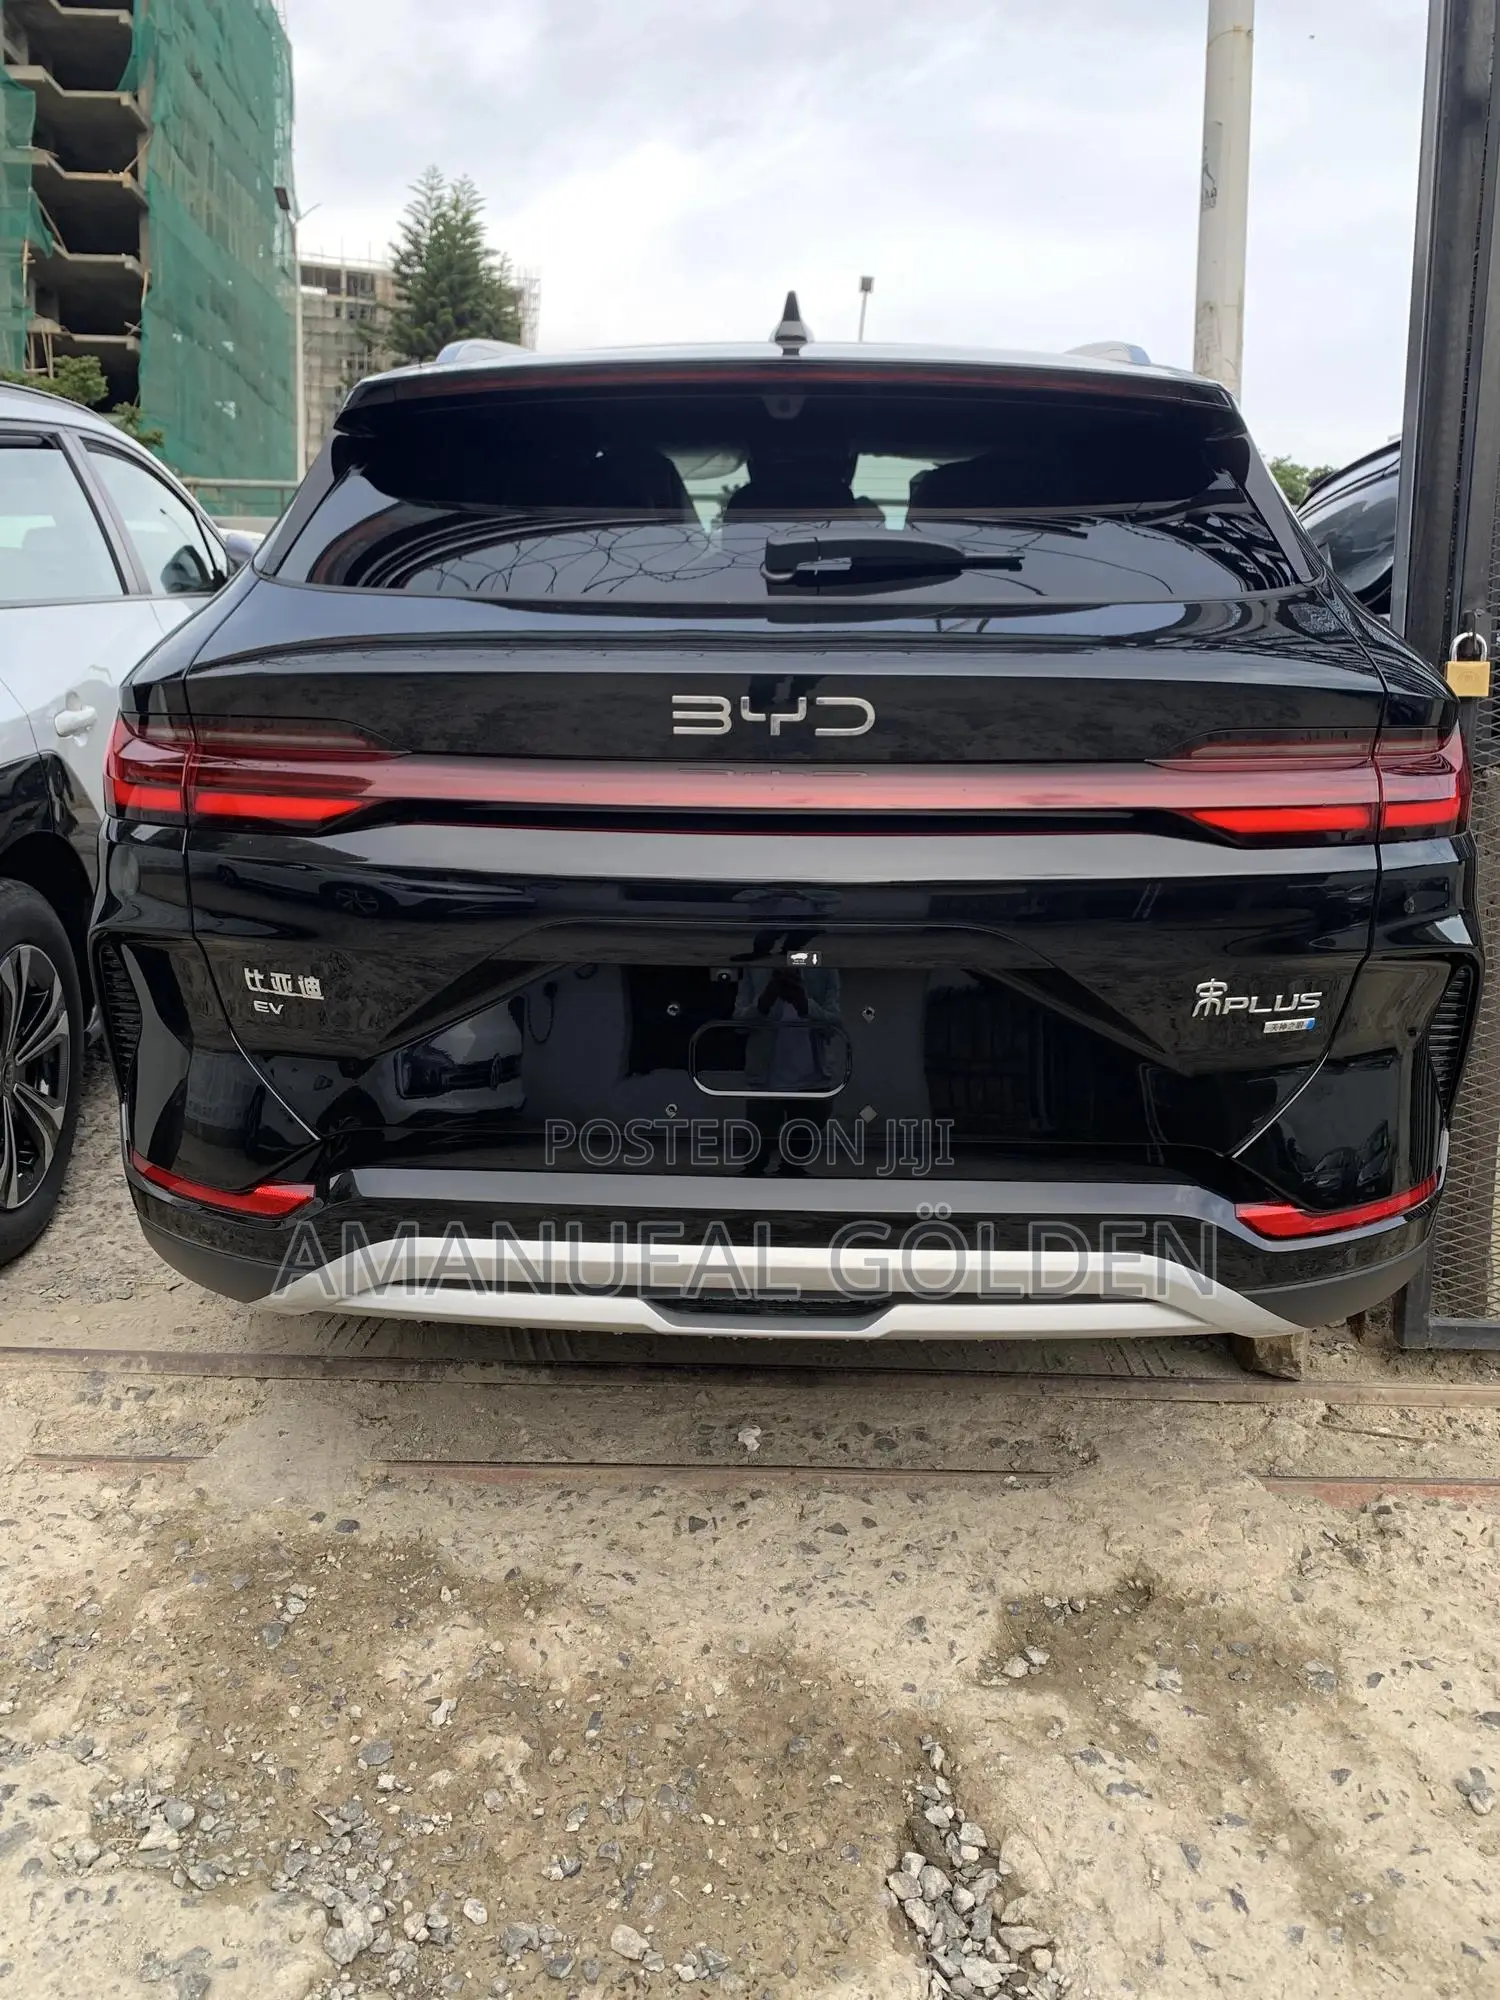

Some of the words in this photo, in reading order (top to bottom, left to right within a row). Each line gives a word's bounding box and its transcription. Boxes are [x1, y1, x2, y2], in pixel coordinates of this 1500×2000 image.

[671, 694, 876, 737] BYD
[243, 967, 325, 1001] 比亚迪
[253, 1000, 284, 1015] EV
